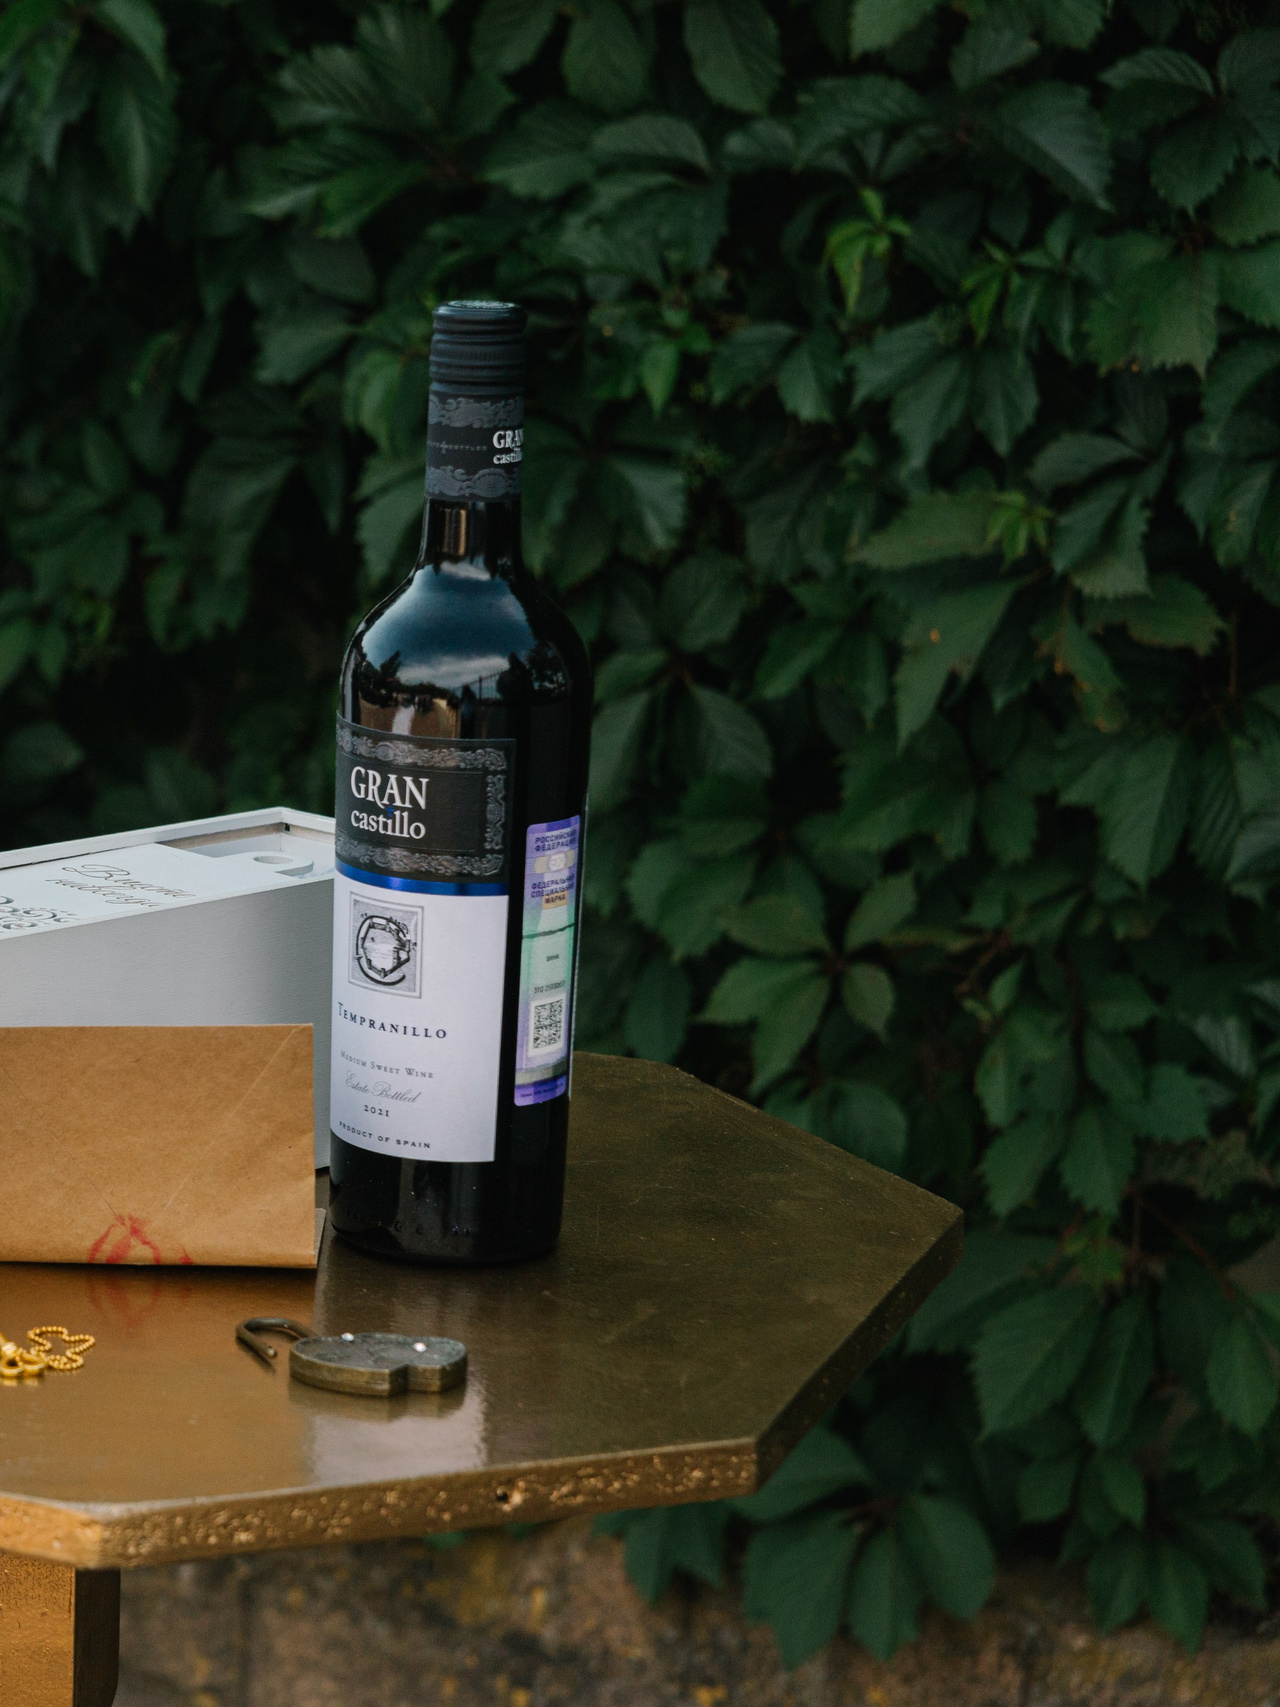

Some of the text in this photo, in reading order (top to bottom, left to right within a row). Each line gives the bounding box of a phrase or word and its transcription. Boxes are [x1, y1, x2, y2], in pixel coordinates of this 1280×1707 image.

[350, 766, 430, 810] GRAN
[351, 810, 426, 839] castillo
[345, 1070, 422, 1103] Estate Bottled
[363, 1105, 390, 1117] 2021
[339, 1121, 431, 1149] PRODUCT OF SPAIN
